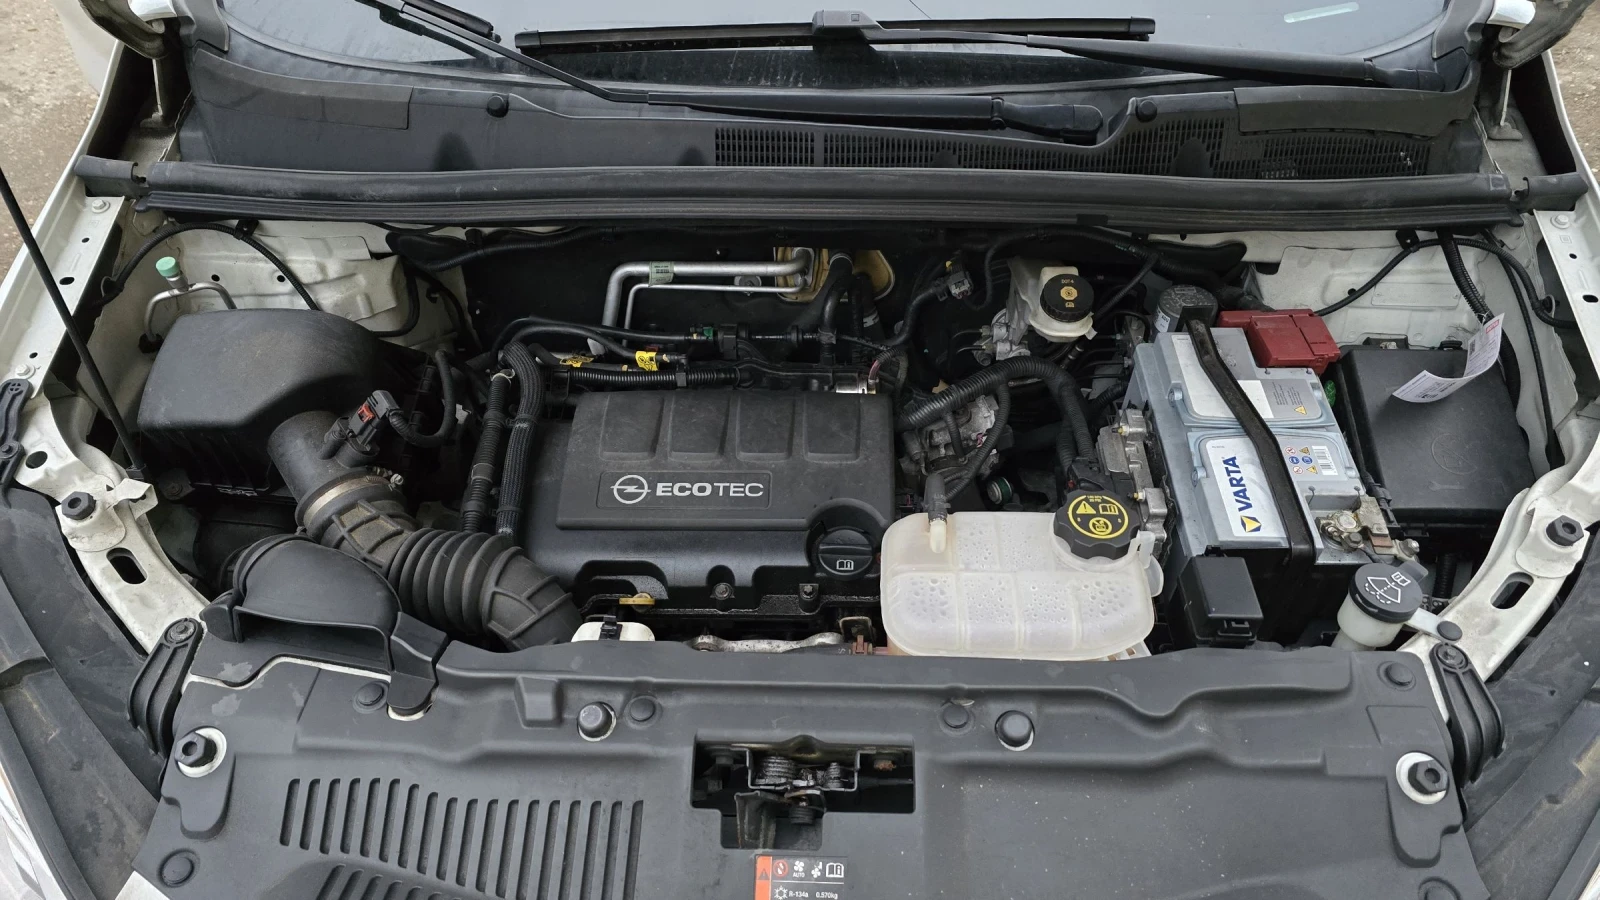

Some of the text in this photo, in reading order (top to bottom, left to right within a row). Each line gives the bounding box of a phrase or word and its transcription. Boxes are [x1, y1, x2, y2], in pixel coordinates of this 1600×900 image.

[656, 482, 764, 497] ECOTEC
[1222, 456, 1253, 512] VARTA
[788, 890, 809, 898] R-134a
